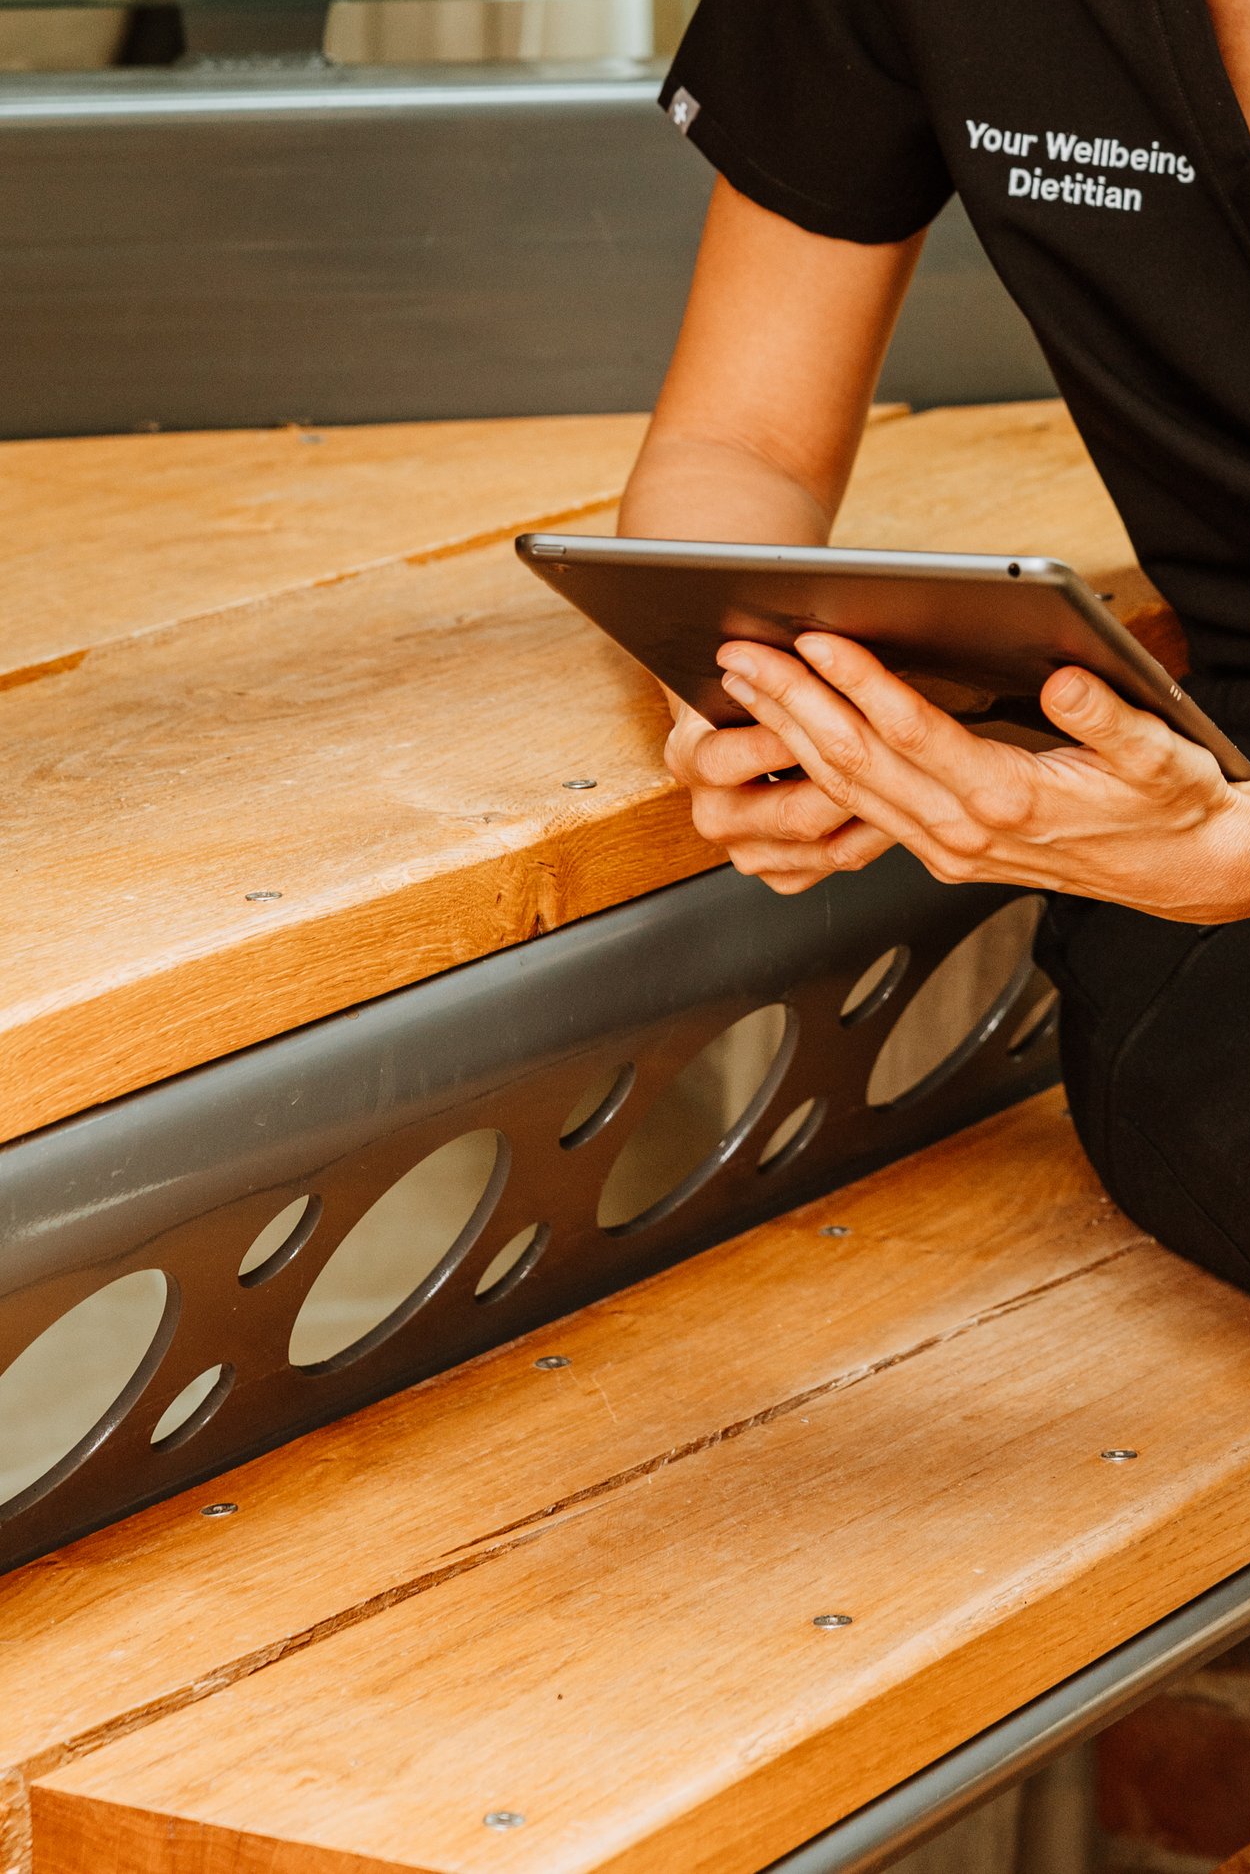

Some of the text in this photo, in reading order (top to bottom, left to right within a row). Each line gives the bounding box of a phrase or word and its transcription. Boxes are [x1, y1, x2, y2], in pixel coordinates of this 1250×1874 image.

[966, 119, 1196, 184] Your Wellbeing
[1008, 167, 1142, 212] Dietitian
